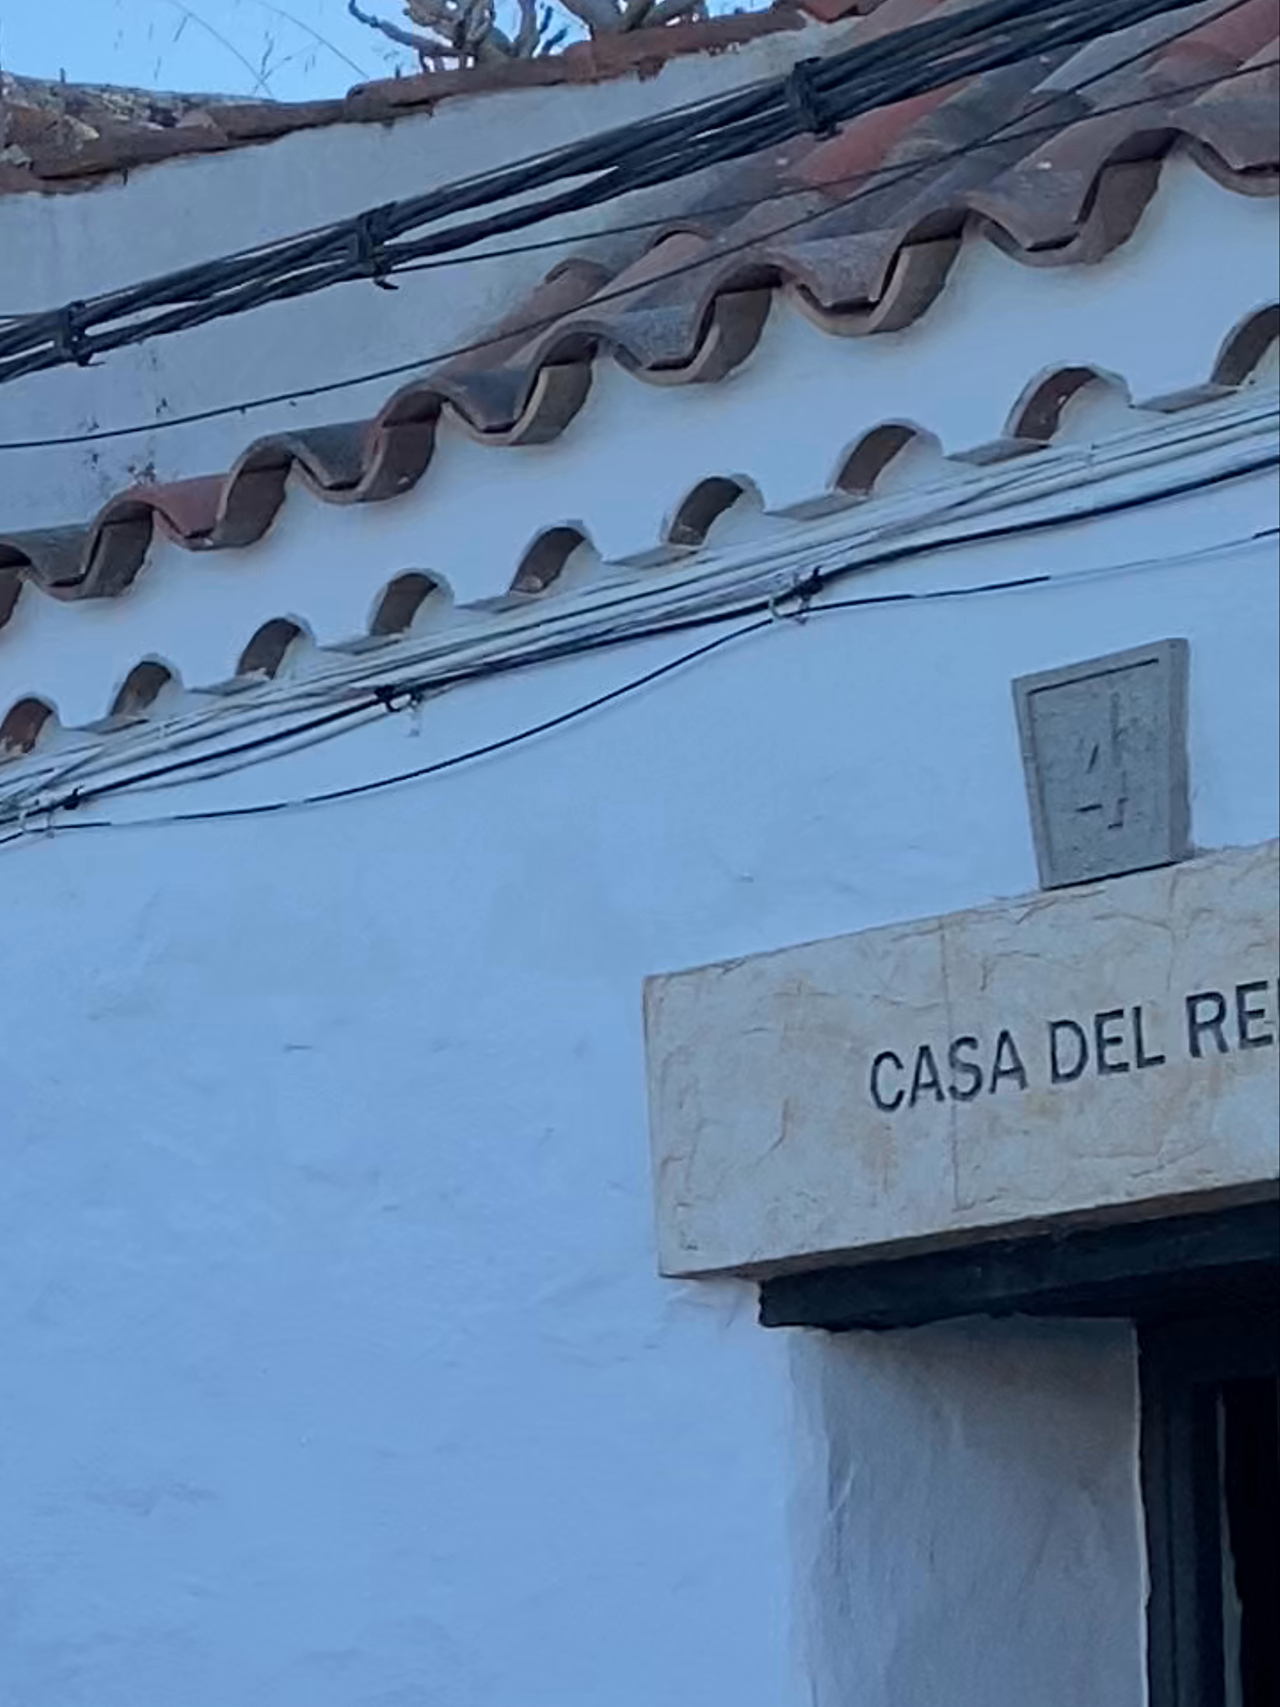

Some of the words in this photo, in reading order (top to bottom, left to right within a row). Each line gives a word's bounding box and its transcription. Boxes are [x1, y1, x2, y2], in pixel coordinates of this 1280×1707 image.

[870, 1029, 1029, 1113] CASA
[1048, 1006, 1167, 1085] DEL
[1185, 979, 1280, 1058] RE
